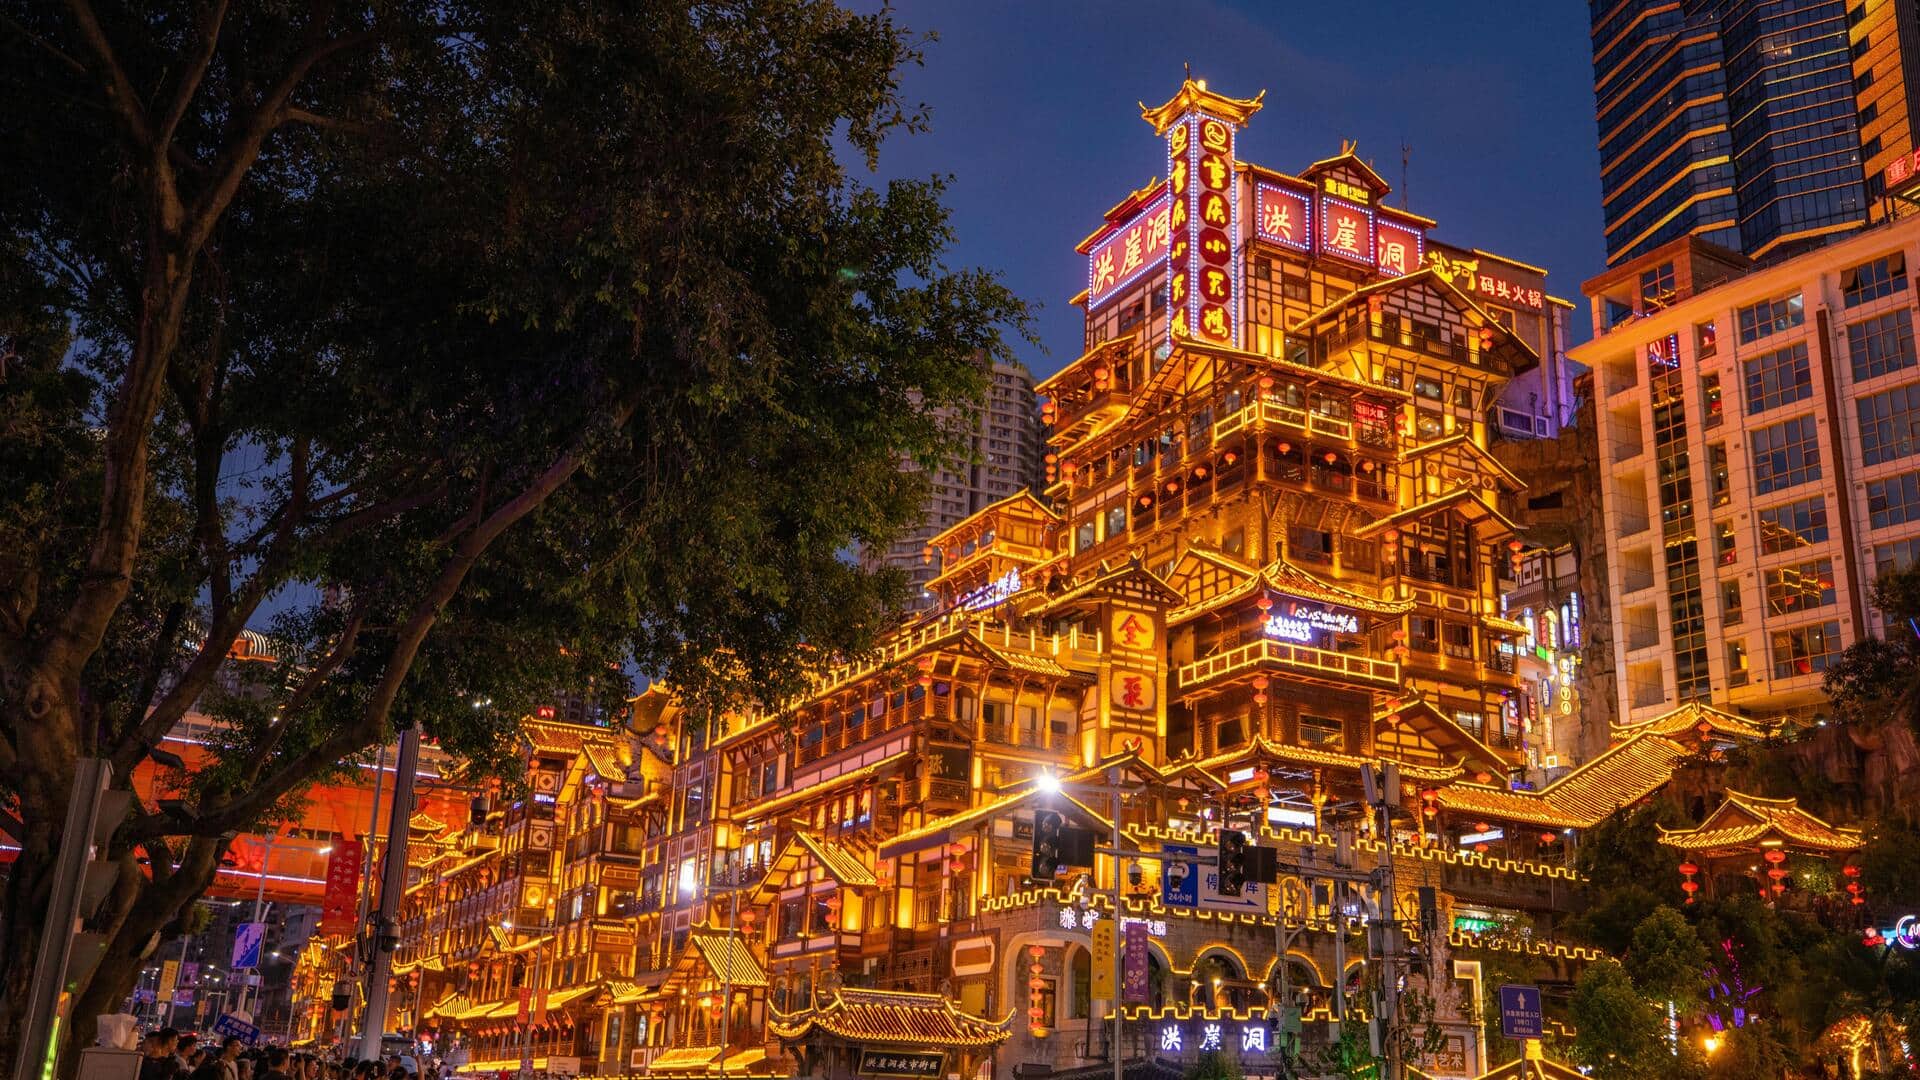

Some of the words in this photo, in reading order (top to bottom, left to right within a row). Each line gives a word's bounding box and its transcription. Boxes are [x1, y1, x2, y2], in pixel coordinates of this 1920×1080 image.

[1093, 209, 1169, 295] 洪崖洞
[1263, 204, 1406, 273] 洪崖洞
[1480, 275, 1543, 308] 码头火锅
[1168, 892, 1193, 903] 24小时
[1206, 872, 1259, 894] 停库
[1161, 1024, 1265, 1051] 洪崖洞
